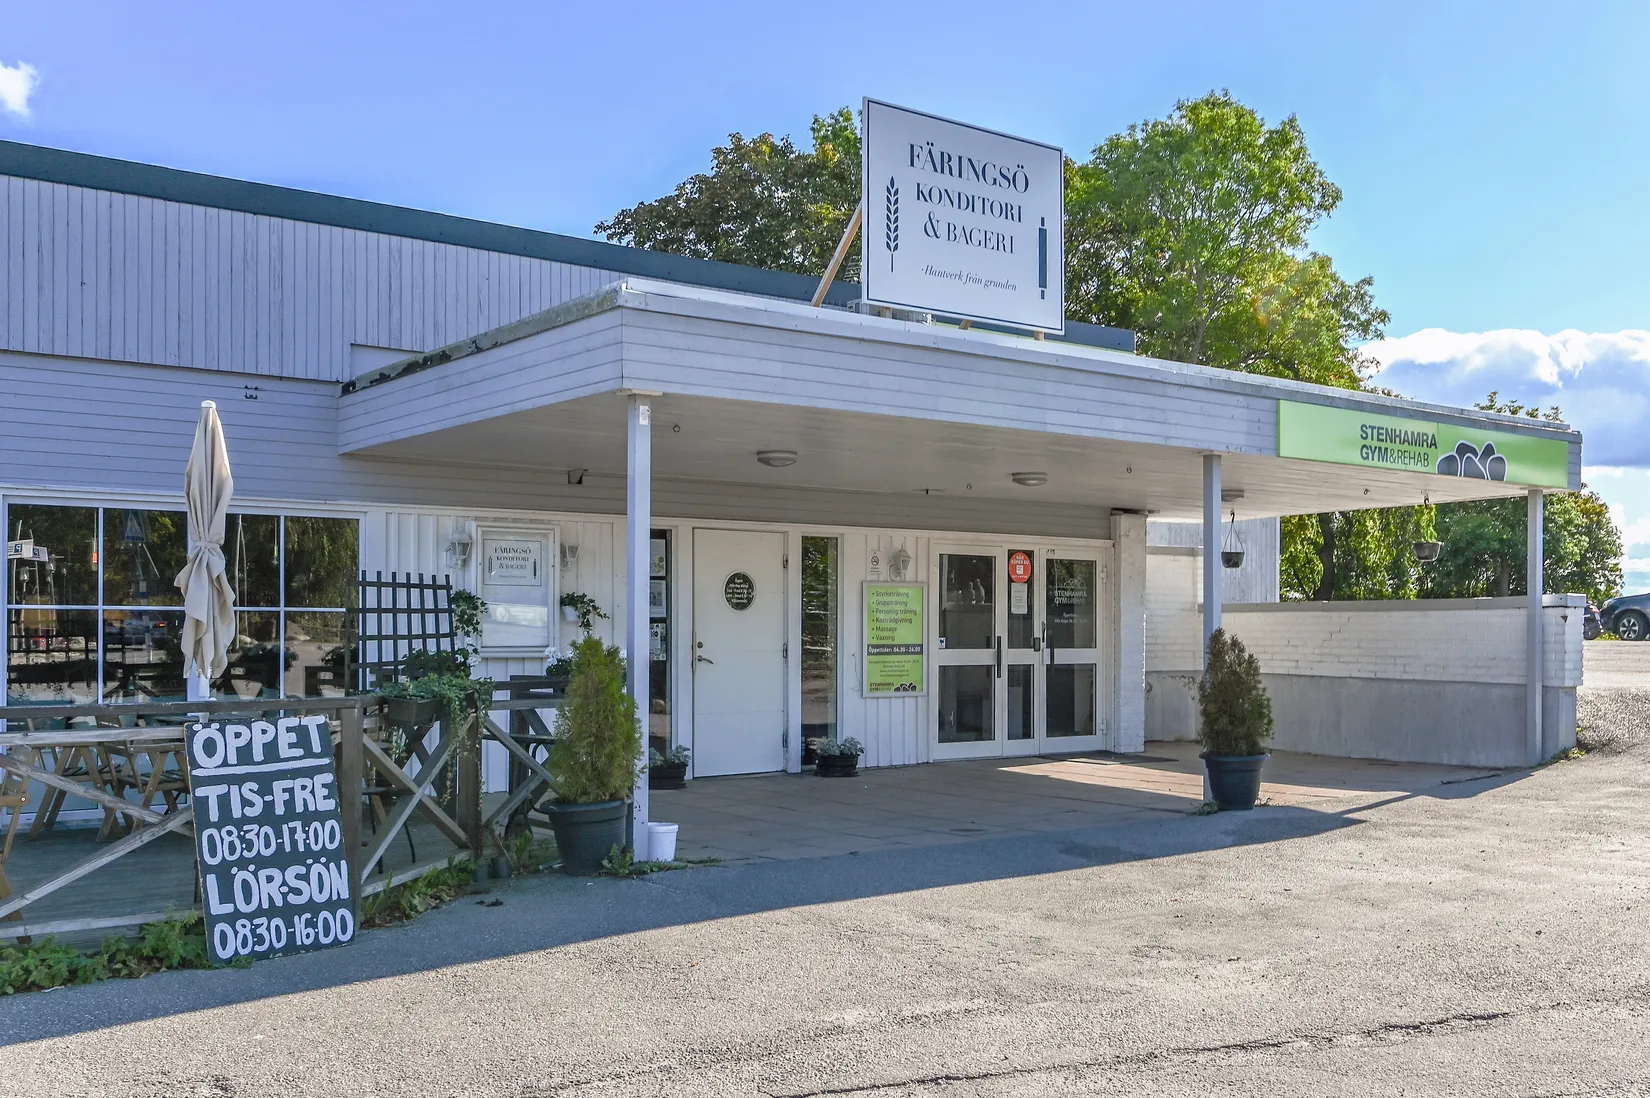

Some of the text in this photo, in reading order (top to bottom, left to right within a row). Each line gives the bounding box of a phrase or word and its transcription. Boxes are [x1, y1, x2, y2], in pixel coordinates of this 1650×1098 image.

[908, 141, 1030, 194] FÄRINGSÖ
[916, 182, 1023, 223] KONDITORI
[923, 210, 1015, 254] & BAGERI
[963, 272, 983, 285] från
[983, 277, 1017, 291] grunden
[1360, 423, 1438, 449] STENHAMRA
[1360, 444, 1430, 468] GYM&REHAB
[494, 546, 532, 554] FÄRINGSÖ
[875, 590, 910, 598] Styrketräning
[875, 599, 908, 607] Gruppträning
[875, 608, 898, 616] Personlig
[875, 634, 896, 642] Vaxning
[192, 715, 327, 768] ÖPPET
[195, 772, 336, 822] TIS-FRE
[202, 819, 341, 865] 08:30-17:00
[206, 856, 350, 916] LÖR-SÖN
[213, 907, 355, 960] 08:30-16:00
